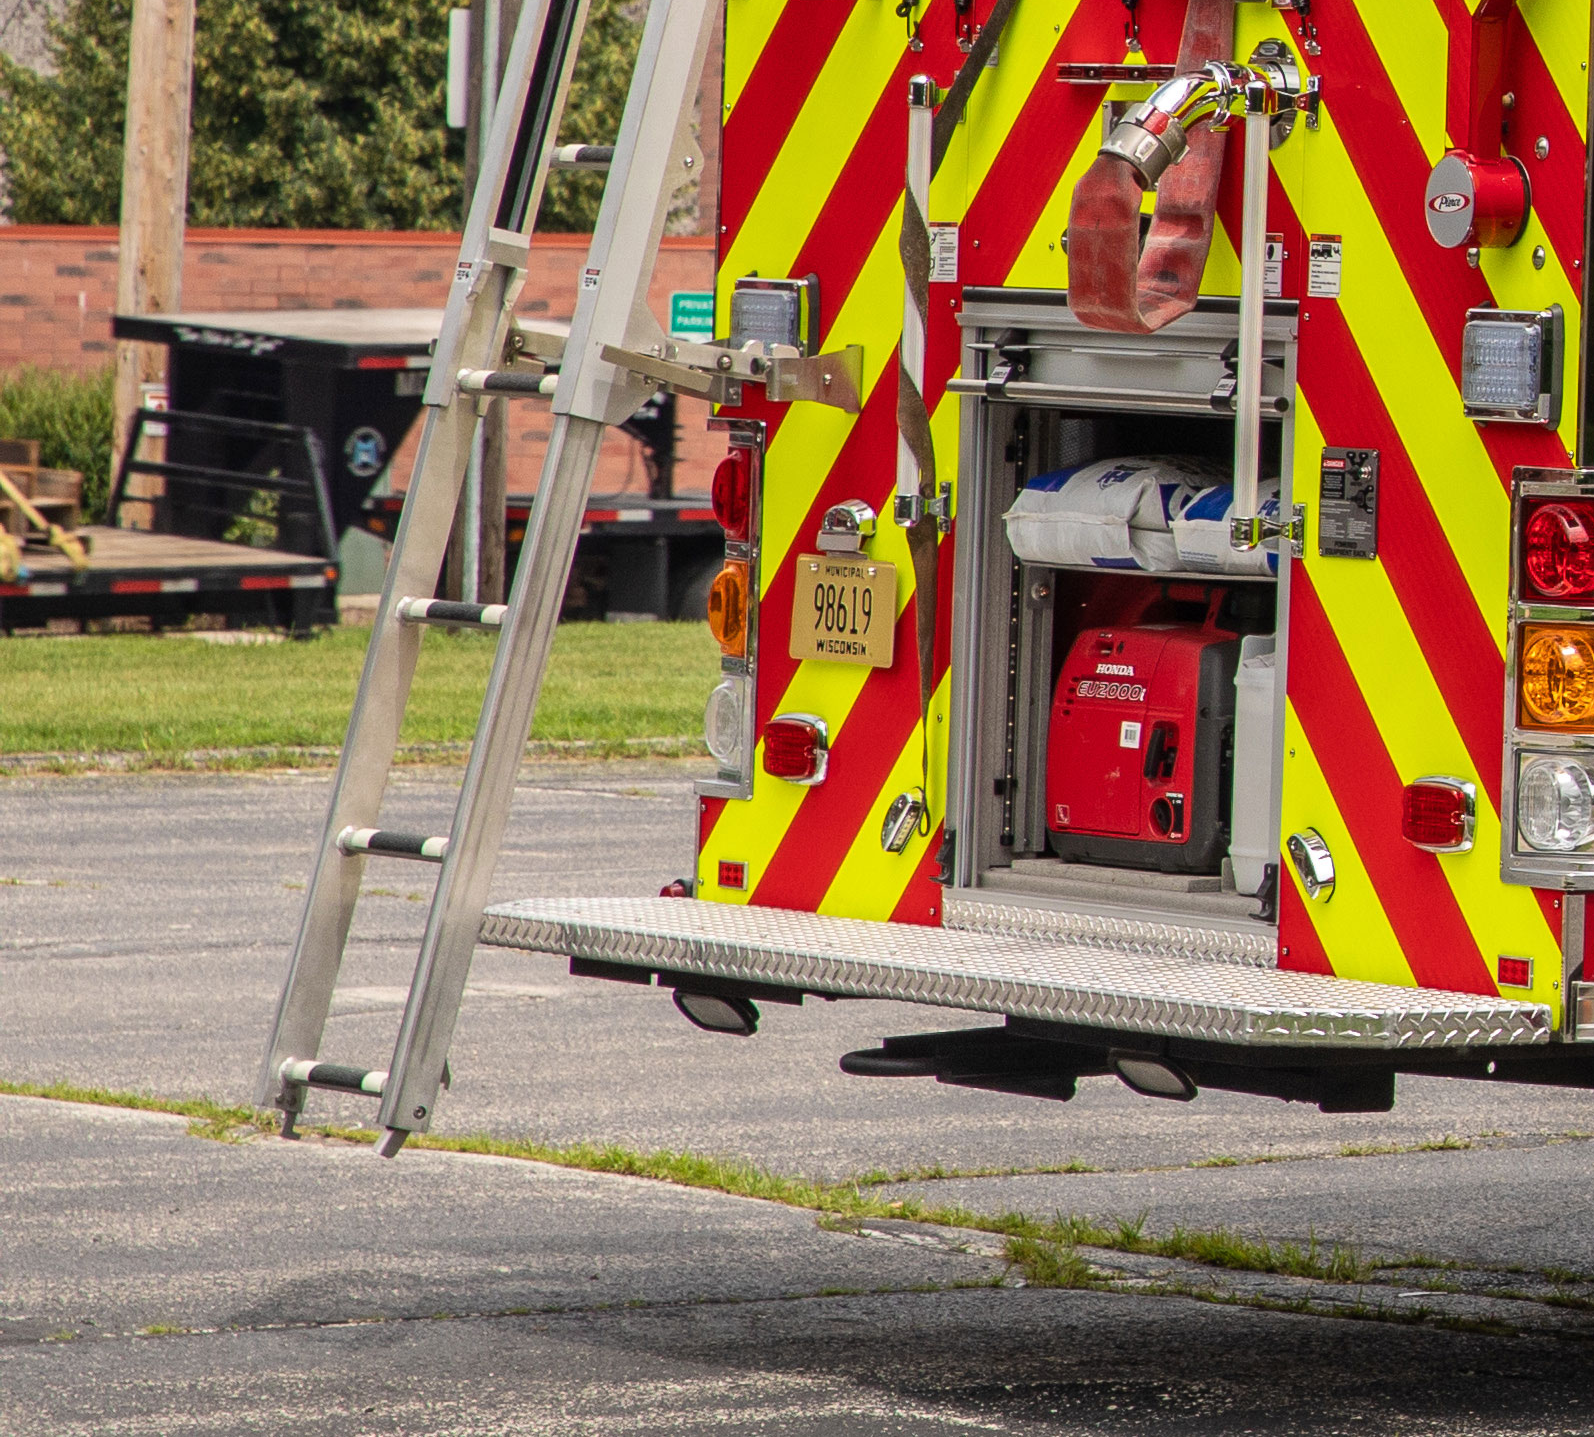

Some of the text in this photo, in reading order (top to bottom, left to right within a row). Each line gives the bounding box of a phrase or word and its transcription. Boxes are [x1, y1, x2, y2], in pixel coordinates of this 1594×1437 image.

[825, 565, 865, 580] MUNICIPAL
[814, 583, 872, 636] 98619
[816, 638, 866, 656] WISCONSIN
[1096, 664, 1135, 677] HONDA
[1077, 680, 1147, 702] EU2000i
